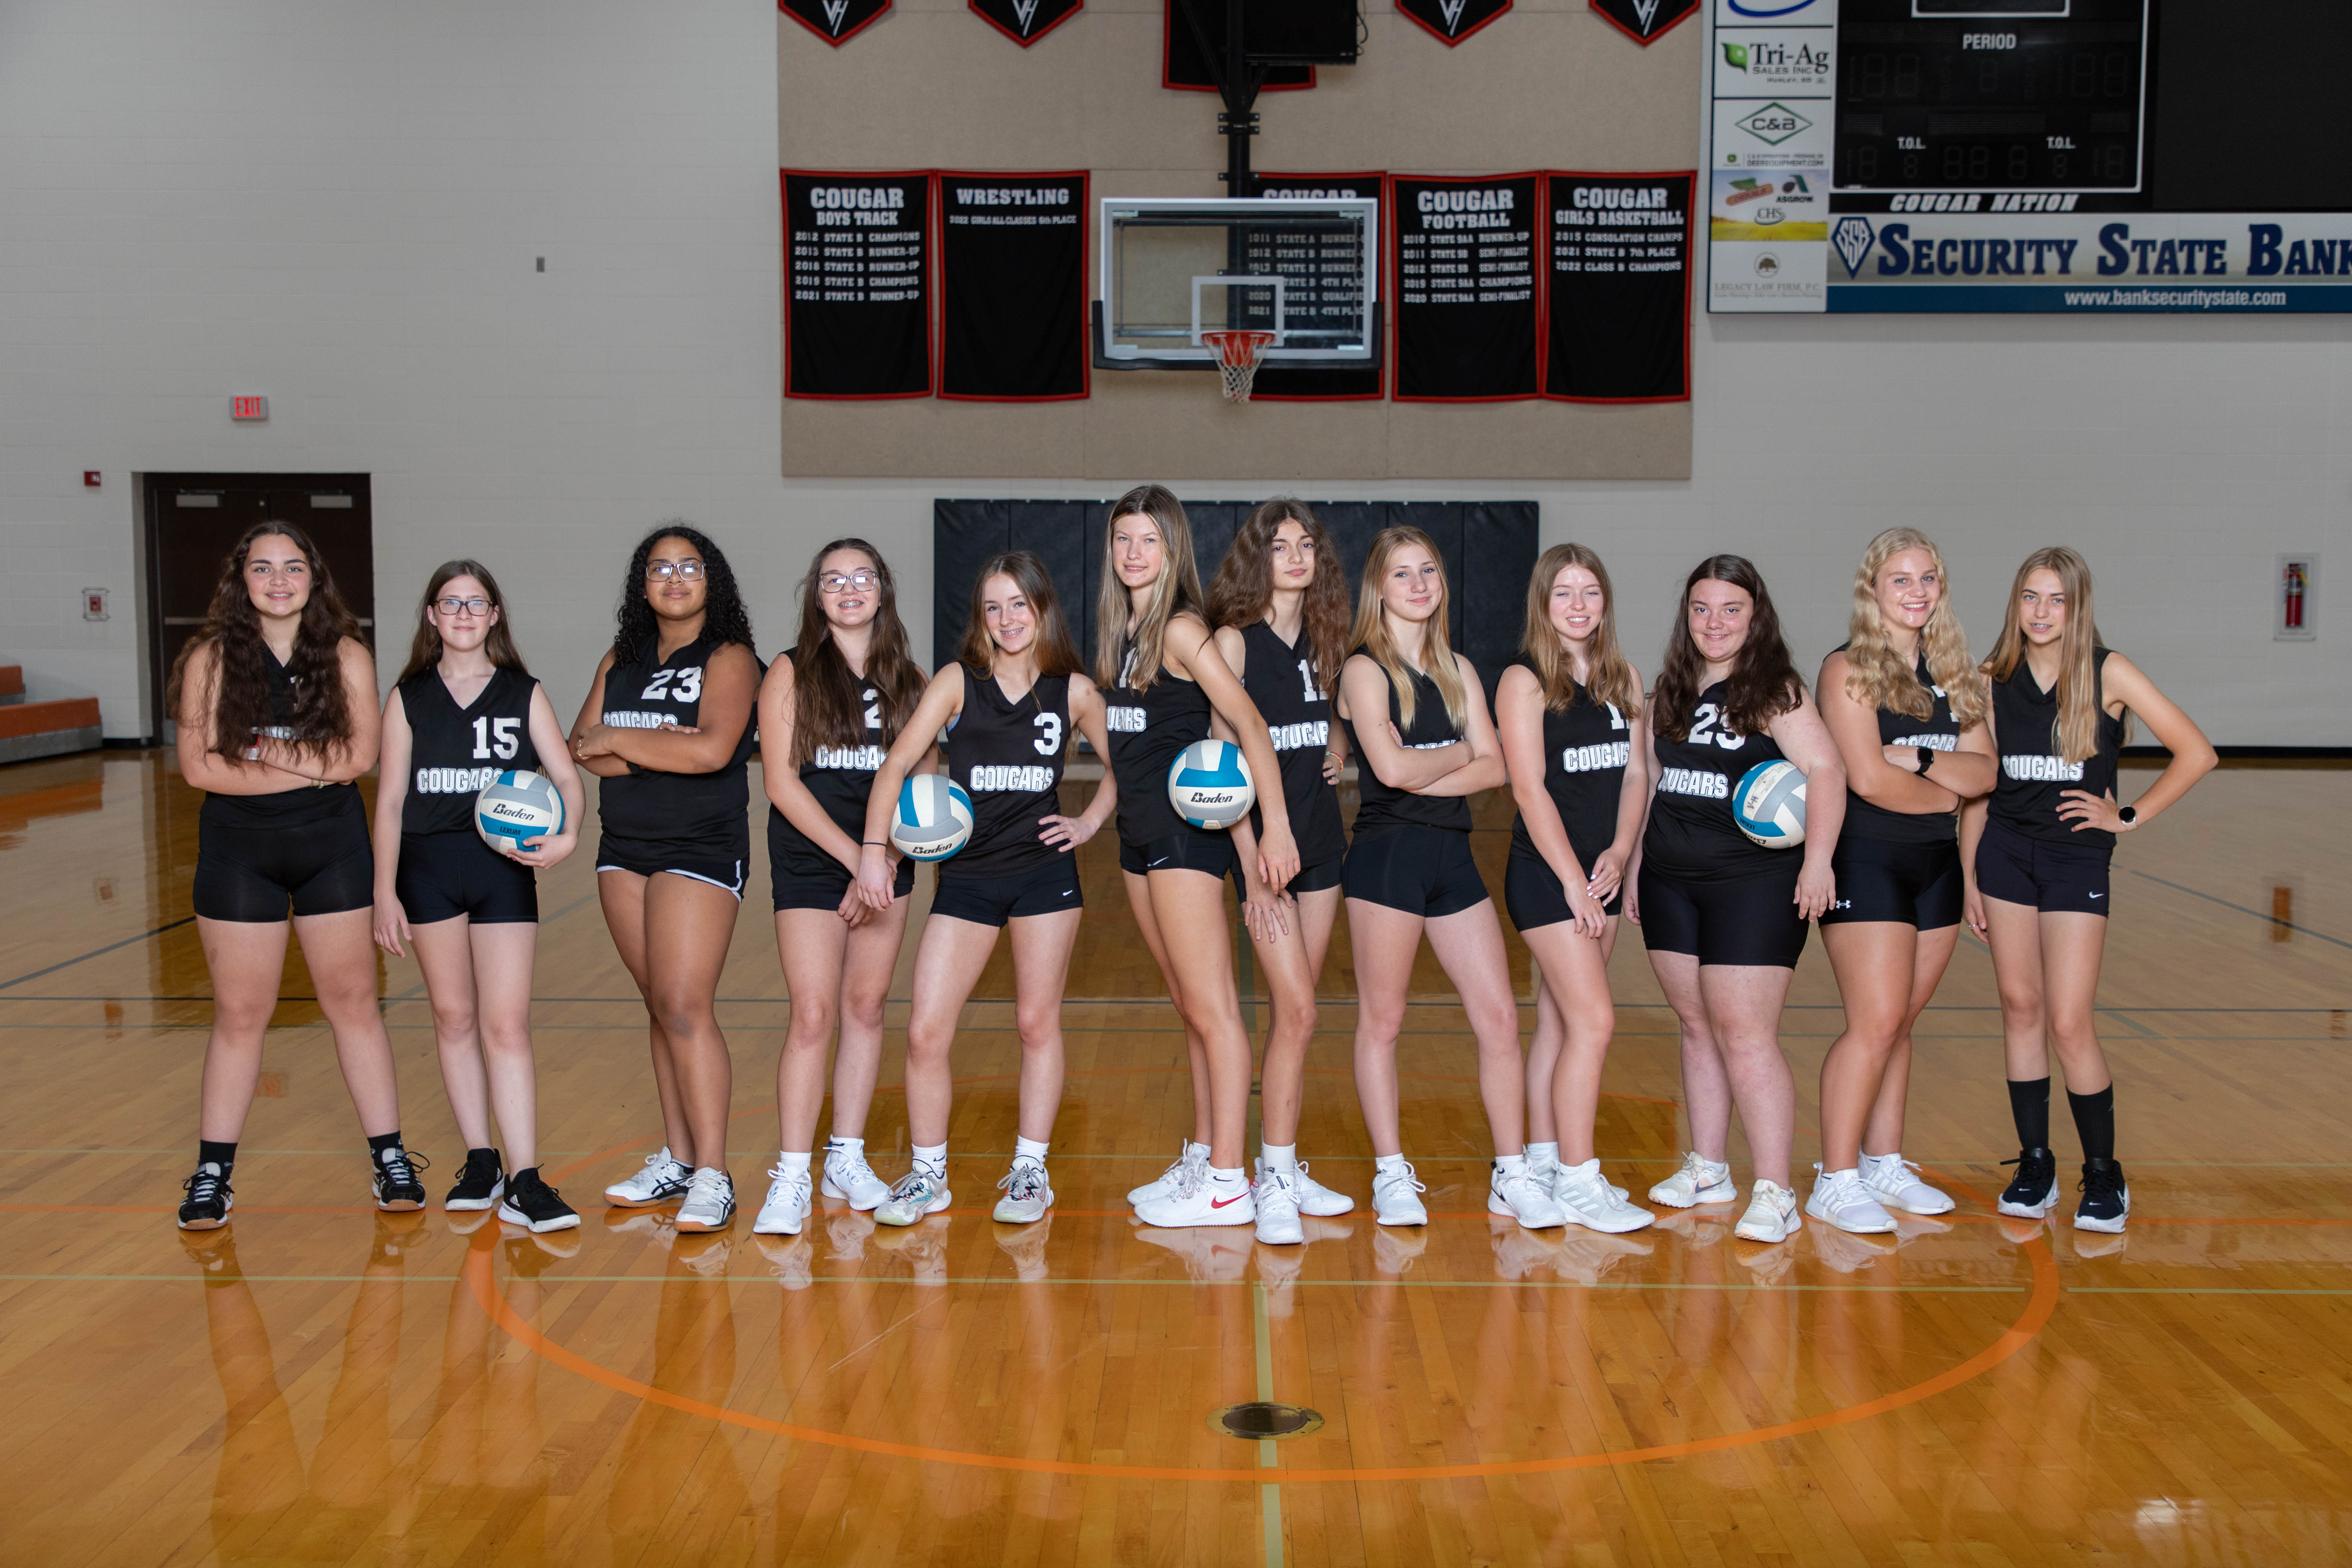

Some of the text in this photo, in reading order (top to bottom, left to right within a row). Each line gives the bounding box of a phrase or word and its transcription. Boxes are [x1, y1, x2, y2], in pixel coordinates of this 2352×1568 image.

[1963, 34, 2017, 49] PERIOD
[1749, 43, 1829, 74] Tri-Ag
[1793, 66, 1812, 74] INC
[1752, 118, 1795, 131] C&B
[1897, 137, 1926, 149] T.O.L.
[2047, 137, 2076, 149] T.O.L.
[810, 187, 904, 209] COUGAR
[957, 188, 1069, 205] WRESTLING
[1418, 189, 1514, 212] COUGAR
[1573, 187, 1668, 209] COUGAR
[1889, 195, 2079, 212] COUGAR NATION
[816, 211, 898, 226] BOYS TRACK
[1052, 215, 1077, 224] PLACE
[1555, 209, 1684, 226] GIRLS BASKETBALL
[1757, 208, 1783, 219] CHS
[1422, 212, 1510, 229] FOOTBALL
[795, 231, 920, 242] 2012 STATE B CHAMPIONS
[1276, 234, 1307, 244] STATE
[1430, 234, 1456, 244] STATE
[1479, 231, 1530, 243] RUNNER-UP
[1555, 231, 1683, 243] 2015 CONSOLATION CHAMPS
[795, 246, 920, 257] 2013 STATE B RUNNER-UP
[1276, 249, 1306, 258] STATE
[1308, 249, 1315, 258] B
[1430, 249, 1456, 259] STATE
[1555, 246, 1580, 256] 2021
[1585, 247, 1616, 257] STATE
[1618, 247, 1626, 257] B
[1647, 247, 1677, 257] PLACE
[795, 260, 919, 272] 2018 STATE B RUNNER-UP
[1276, 263, 1307, 273] STATE
[1308, 263, 1316, 273] B
[1430, 263, 1456, 273] STATE
[1555, 260, 1682, 272] 2022 CLASS B CHAMPIONS
[795, 275, 919, 287] 2019 STATE B CHAMPIONS
[1309, 278, 1316, 287] B
[1430, 278, 1456, 288] STATE
[1479, 275, 1532, 287] CHAMPIONS
[795, 290, 919, 301] 2021 STATE B RUNNER-UP
[1309, 291, 1317, 301] B
[1431, 293, 1457, 303] STATE
[2064, 289, 2287, 309] www.banksecuritystate.com
[1309, 306, 1317, 316] B
[235, 396, 262, 417] EXIT
[641, 666, 702, 703] 23
[473, 716, 520, 760] 15
[1034, 713, 1062, 755] 3
[970, 766, 1054, 792] COUGARS
[1190, 792, 1233, 803] Baden
[492, 803, 534, 821] Baden
[499, 826, 521, 836] LEXUM
[912, 843, 952, 854] Baden
